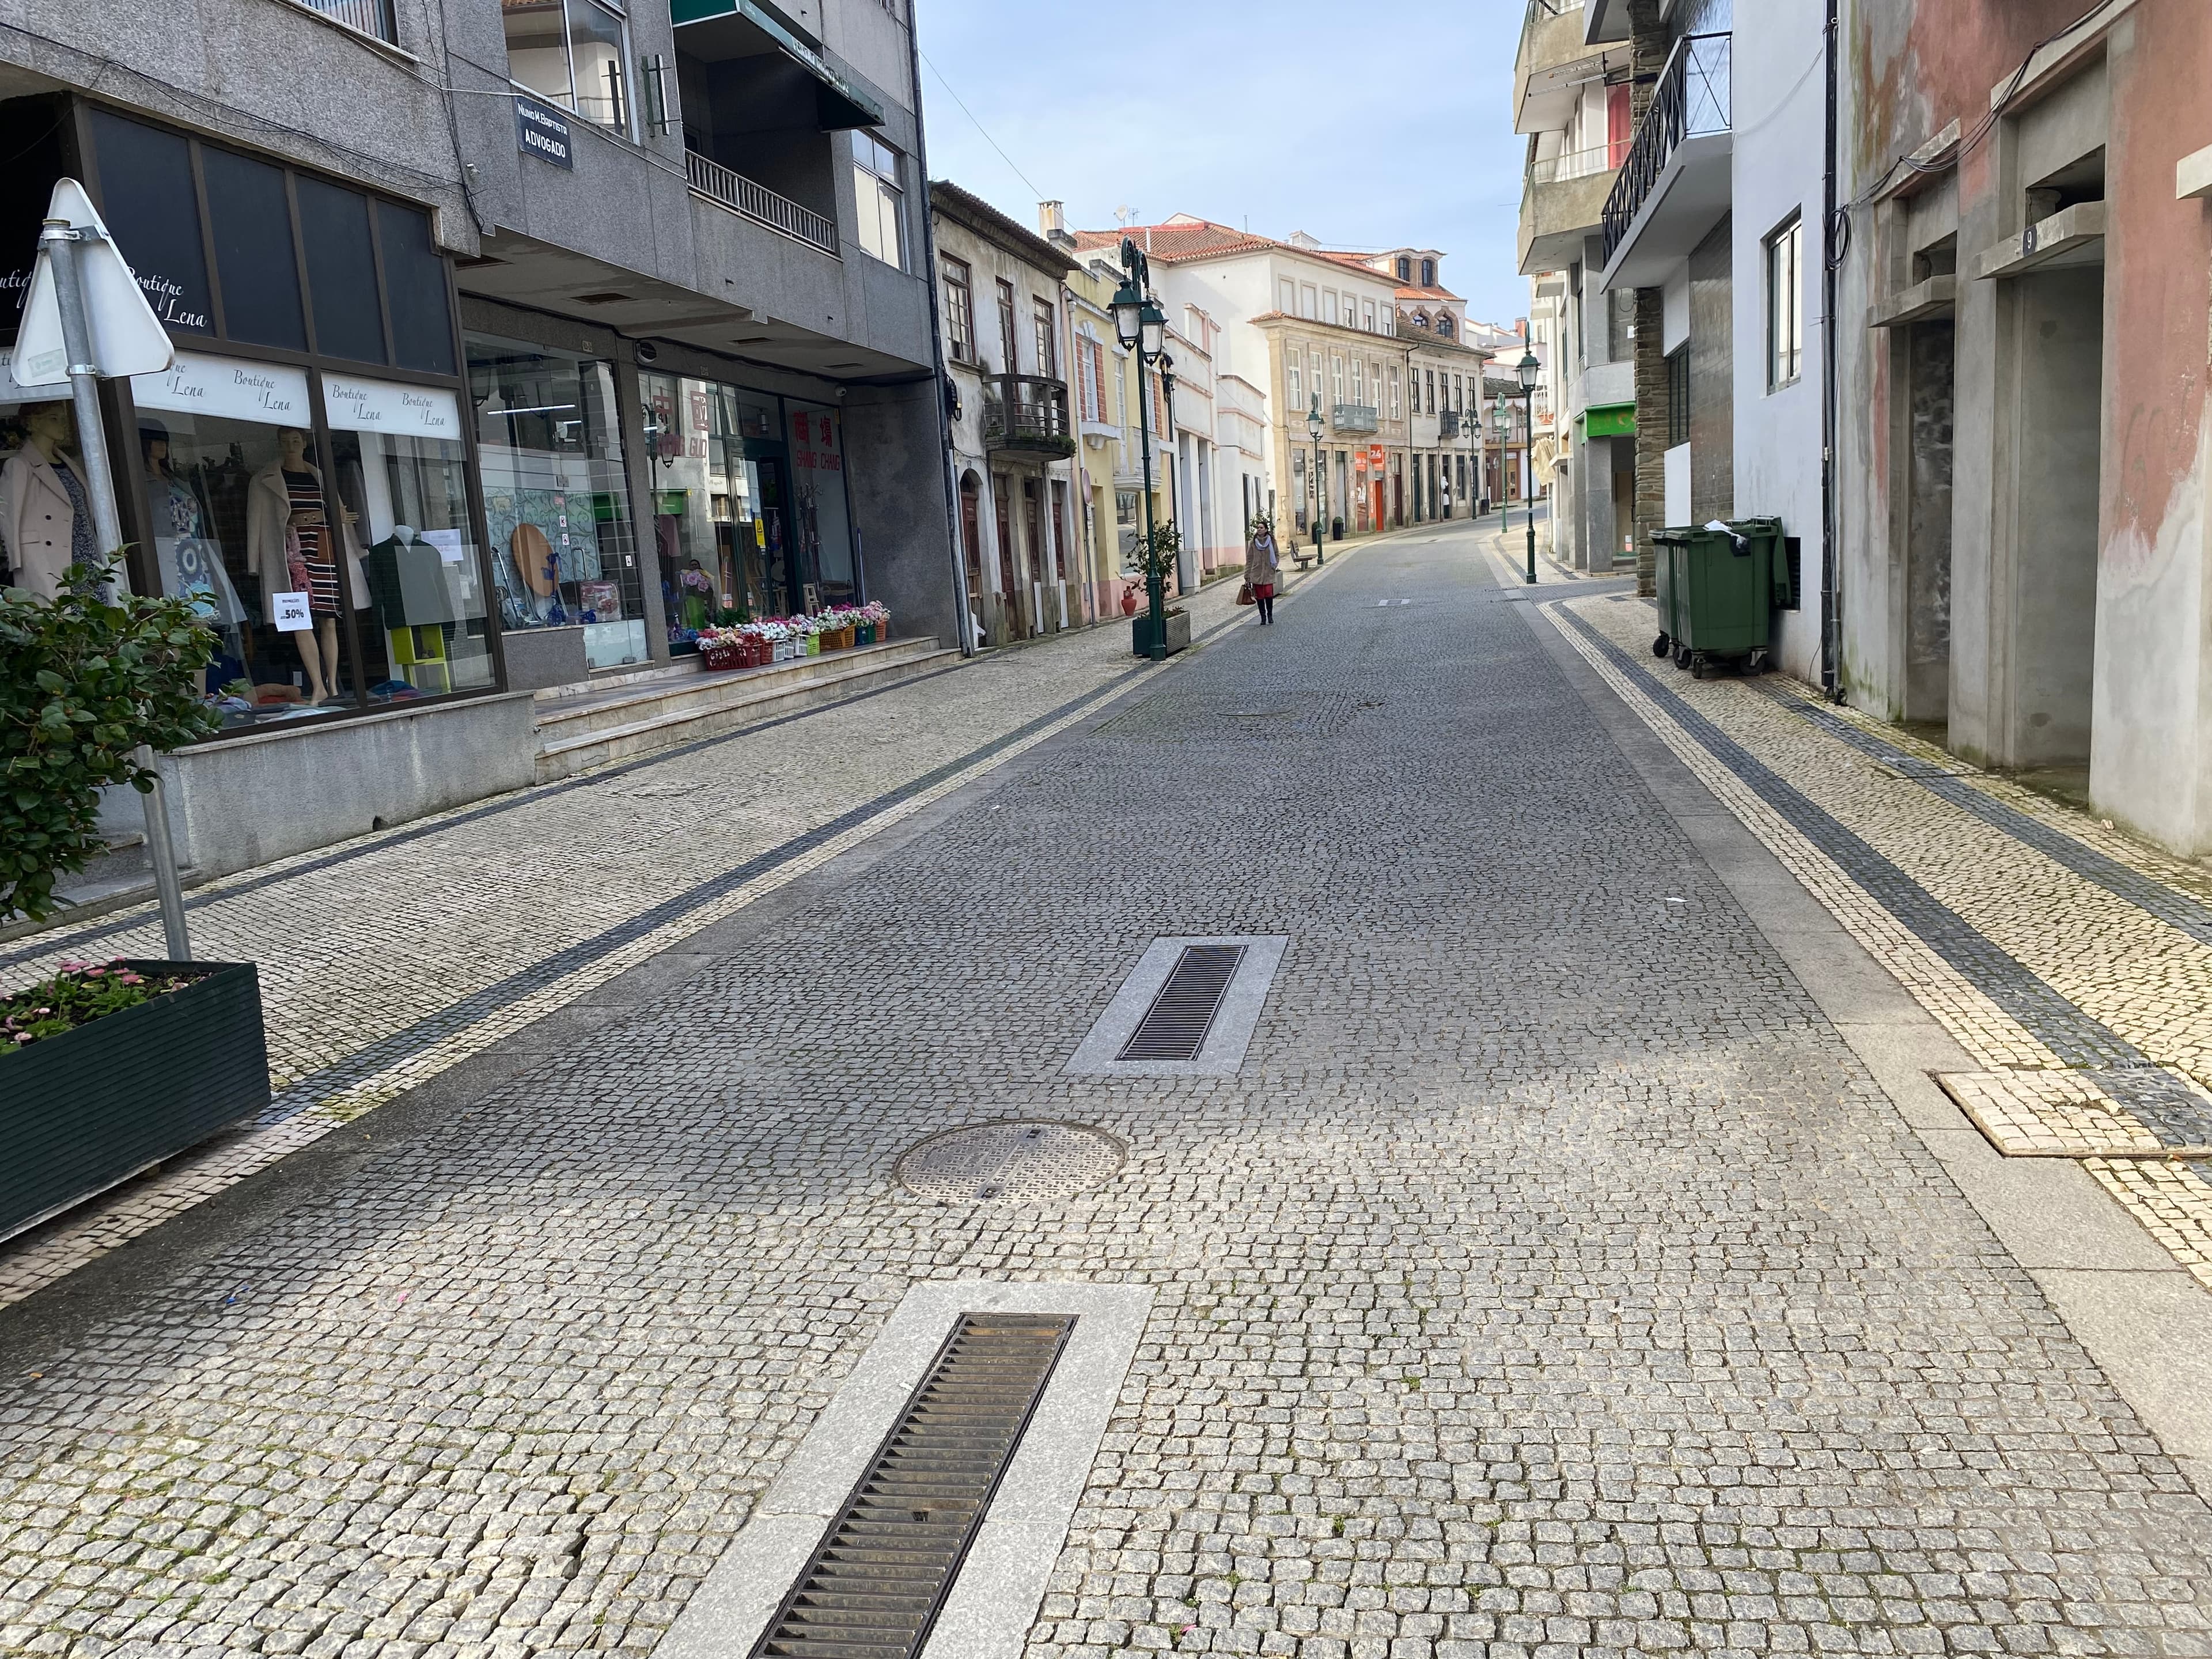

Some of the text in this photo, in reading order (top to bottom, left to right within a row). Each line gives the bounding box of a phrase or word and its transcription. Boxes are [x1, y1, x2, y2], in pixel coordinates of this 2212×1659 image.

[525, 128, 566, 158] ADVOGADO
[2027, 231, 2032, 249] 9
[164, 298, 207, 327] Lena
[172, 376, 204, 397] Lena
[233, 369, 275, 402] Boutique
[263, 391, 291, 411] Lena
[332, 384, 368, 413] Boutique
[402, 392, 433, 419] Boutique
[357, 403, 381, 421] Lena
[424, 410, 445, 427] Lena
[690, 437, 707, 458] GUO
[797, 449, 817, 468] SHANG
[820, 452, 840, 471] CHANG
[1370, 450, 1381, 459] 24
[285, 609, 304, 619] 50%
[993, 1143, 1029, 1182] SANEAMENTO
